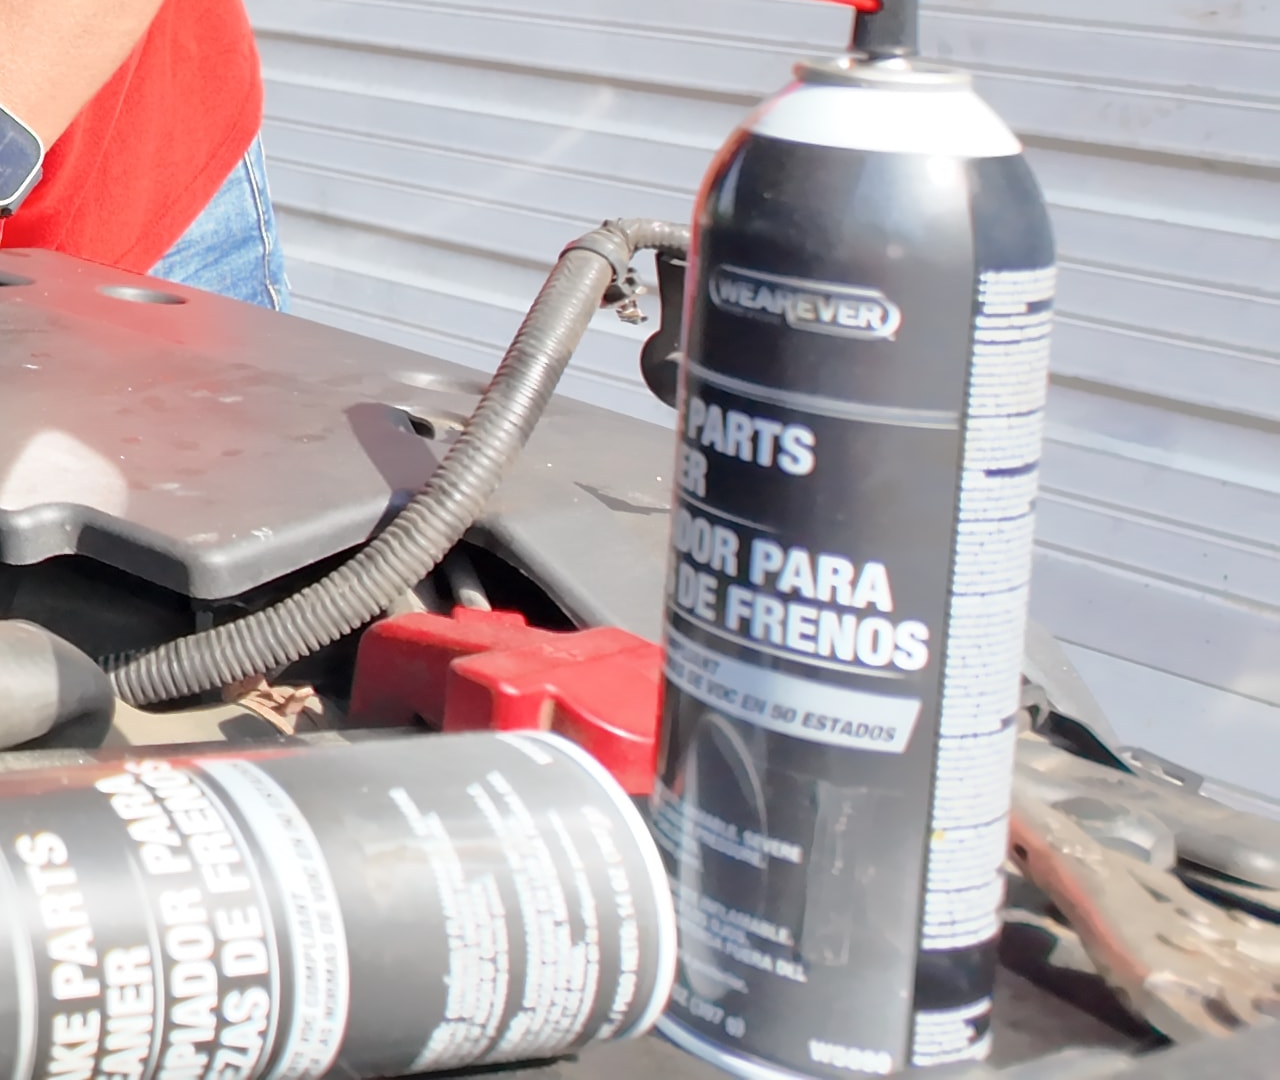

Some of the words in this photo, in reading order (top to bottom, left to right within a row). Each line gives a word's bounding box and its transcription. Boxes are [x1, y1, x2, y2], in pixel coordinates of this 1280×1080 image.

[718, 276, 886, 330] WEAREVER
[686, 397, 816, 476] PARTS
[748, 538, 894, 612] PARA
[677, 563, 717, 622] DE
[725, 583, 930, 672] FRENOS
[741, 693, 767, 715] EN
[771, 703, 797, 724] 50
[801, 712, 897, 743] ESTADOS
[95, 771, 192, 876] PARA
[16, 831, 101, 1001] PARTS
[215, 905, 270, 978] DE
[290, 890, 320, 1010] COMPLIANT
